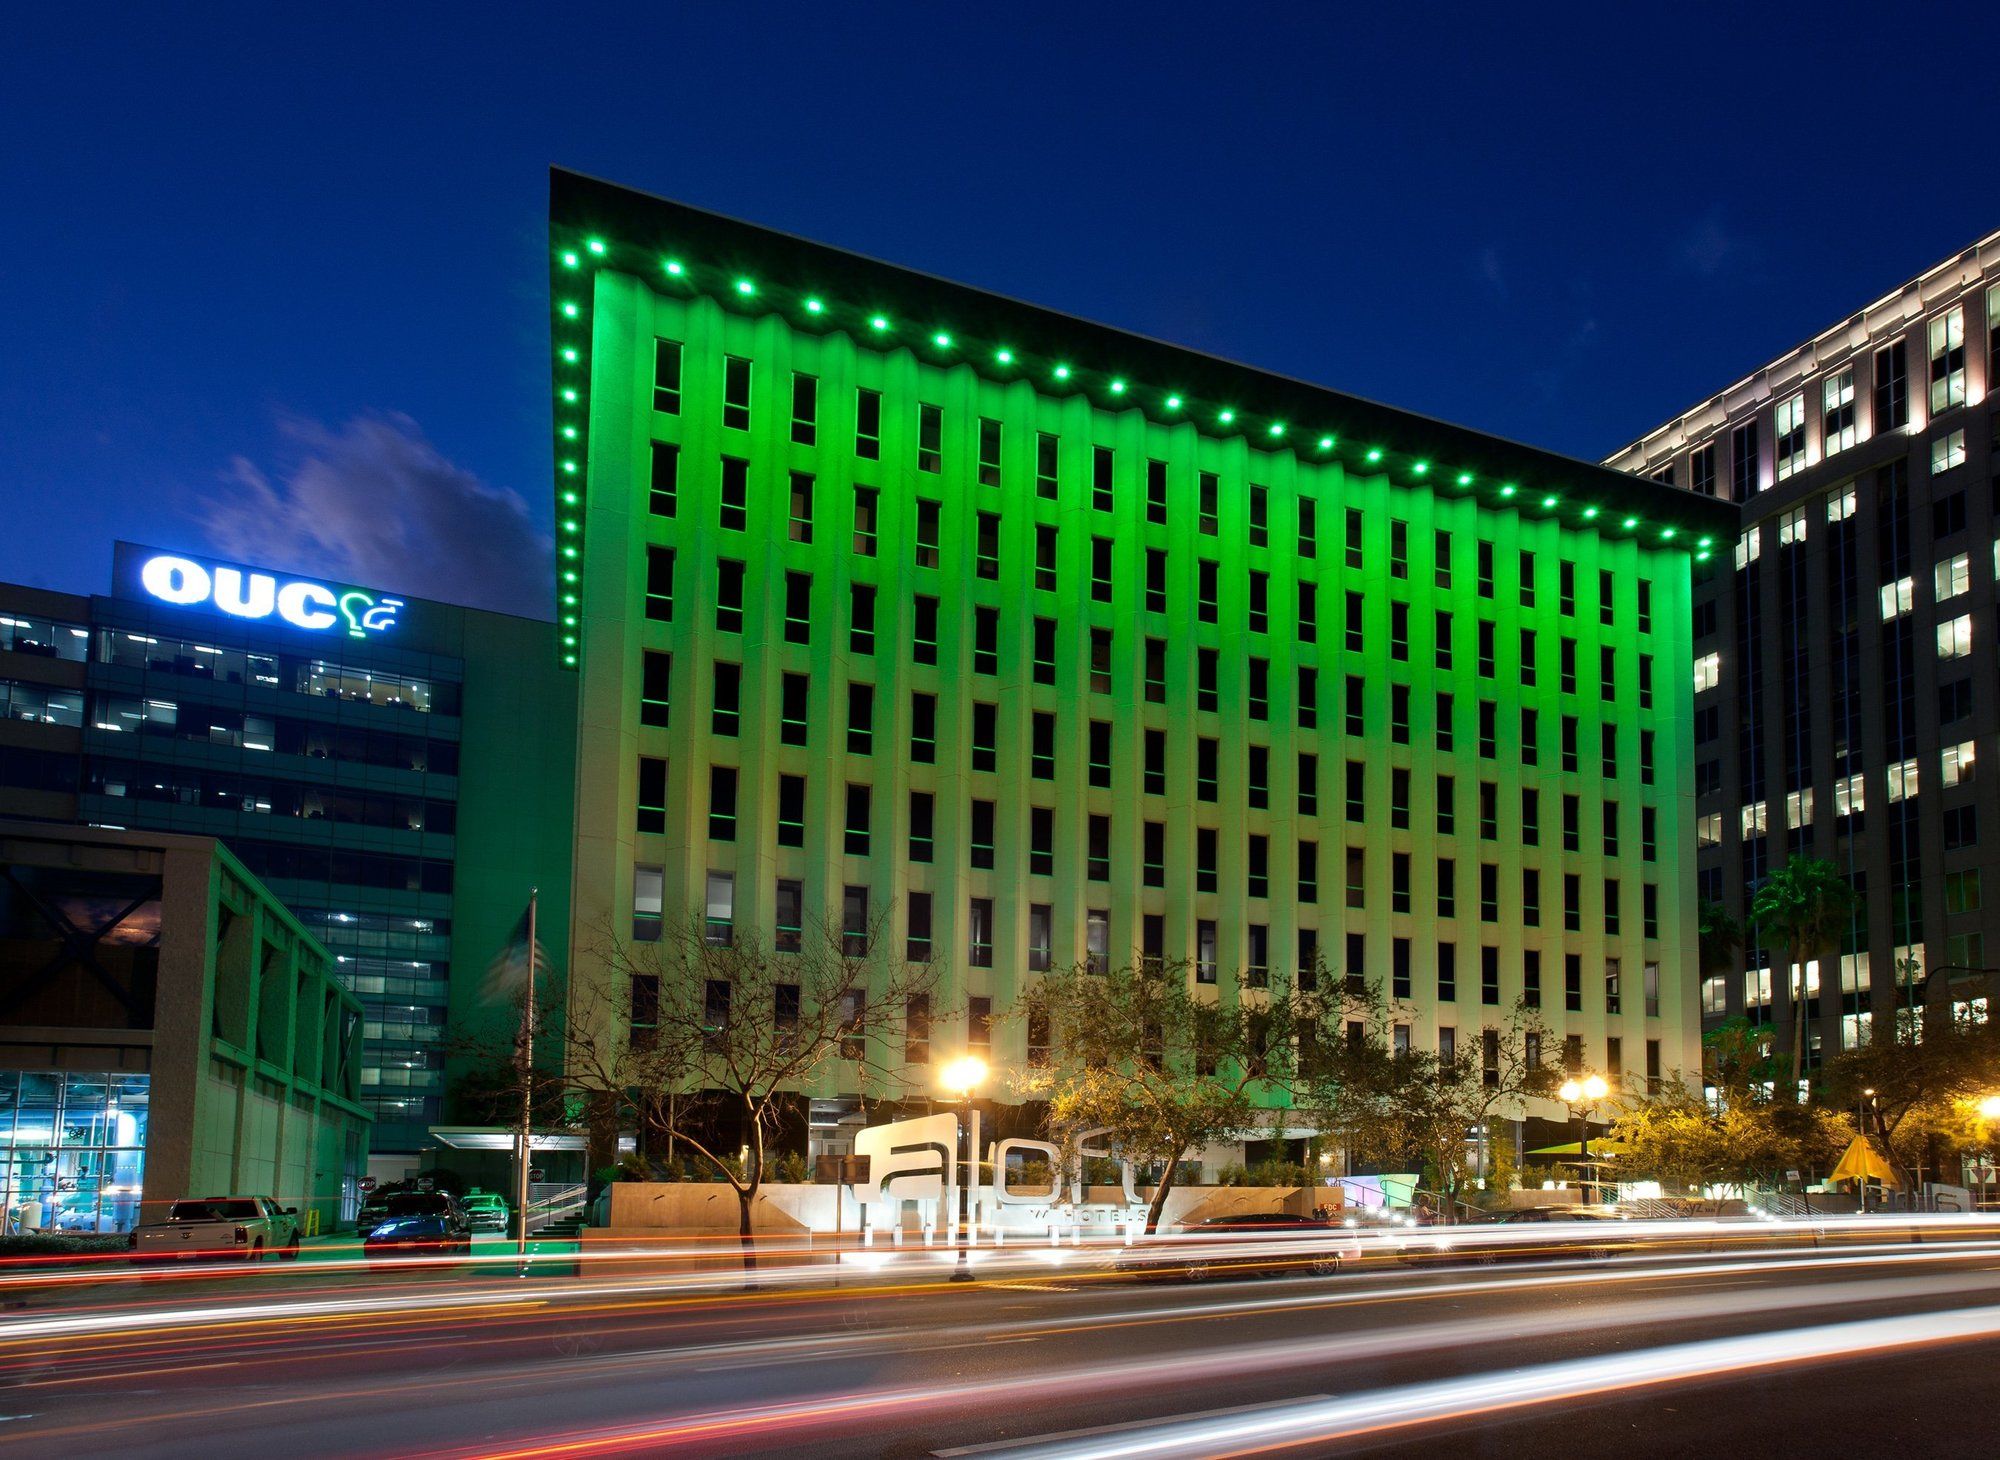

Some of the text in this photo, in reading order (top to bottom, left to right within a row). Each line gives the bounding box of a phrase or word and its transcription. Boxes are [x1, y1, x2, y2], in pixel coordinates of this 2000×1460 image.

[142, 556, 337, 629] OUC
[853, 1110, 1143, 1204] aloft
[1064, 1209, 1146, 1222] HOTELS
